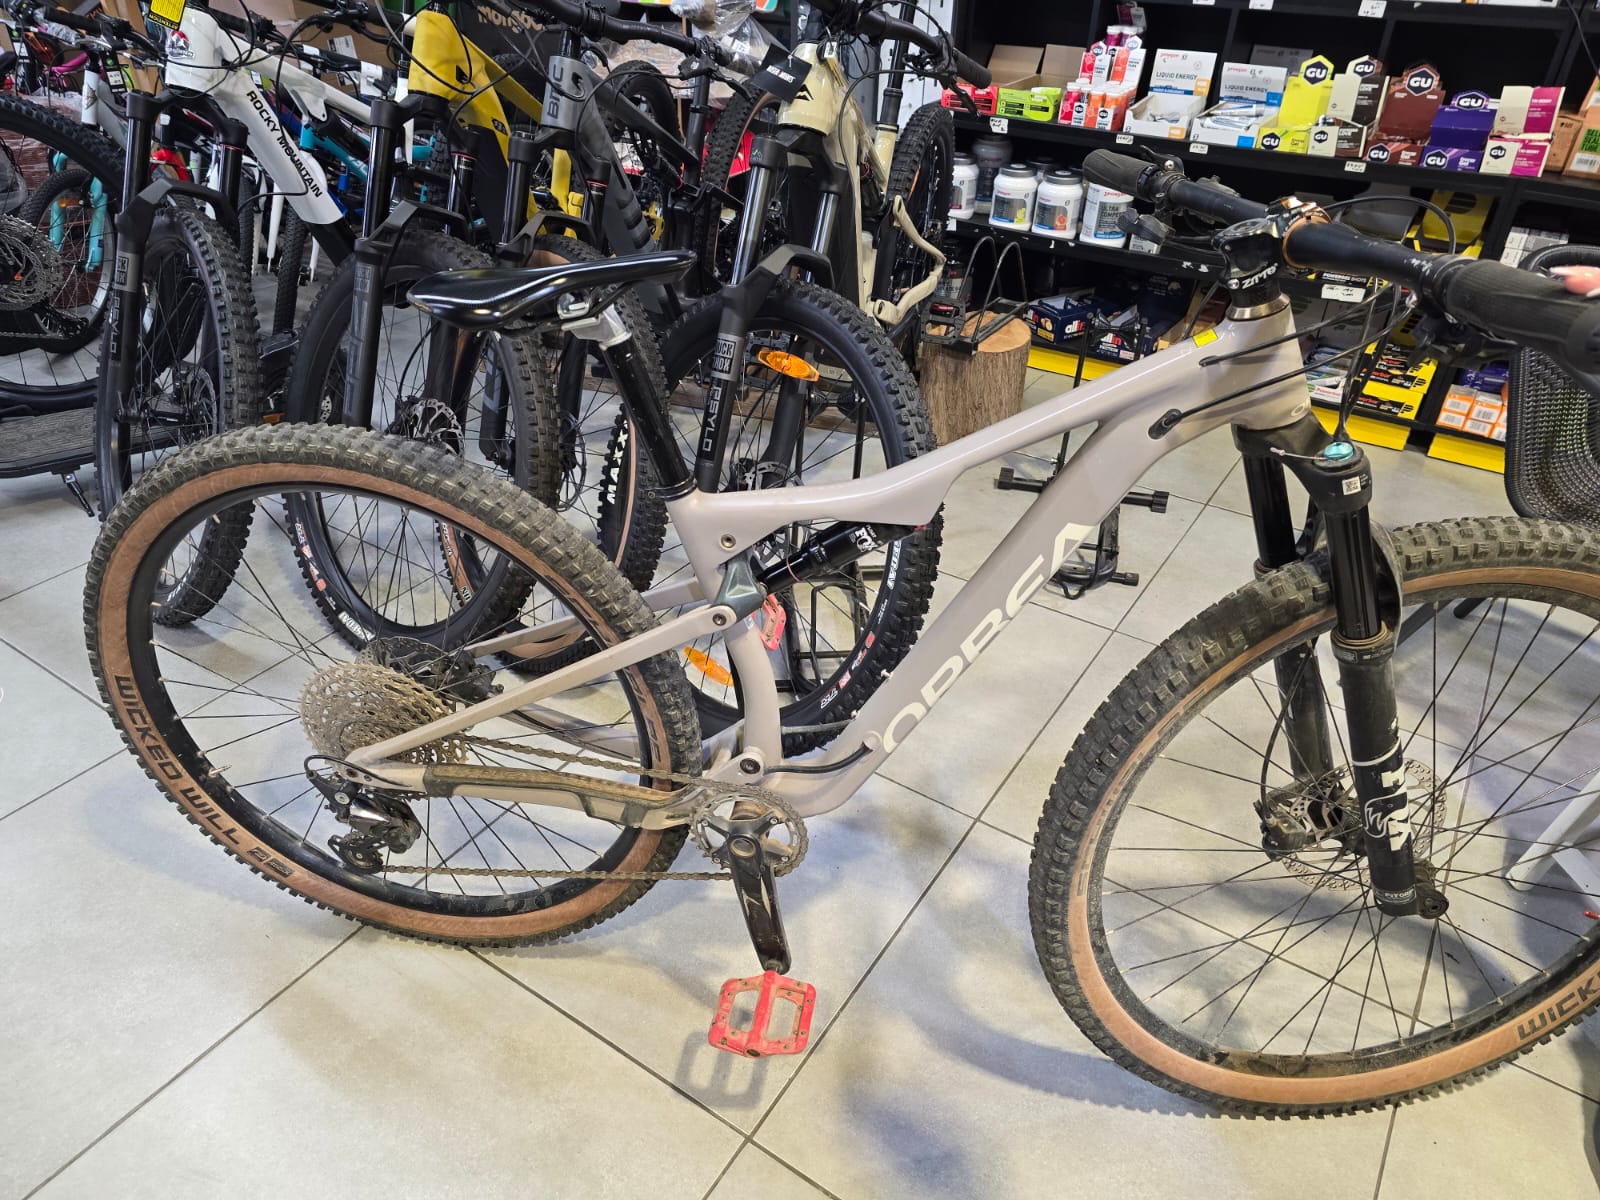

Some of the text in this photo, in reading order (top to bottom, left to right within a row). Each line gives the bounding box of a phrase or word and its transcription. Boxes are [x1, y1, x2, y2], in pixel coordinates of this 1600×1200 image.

[1306, 67, 1327, 78] GU
[1355, 63, 1374, 73] GU
[1156, 71, 1198, 81] LIQUID ENERGY
[1408, 76, 1433, 89] GU
[1225, 84, 1269, 93] LIQUID ENERGY
[1458, 97, 1485, 108] GU
[246, 91, 281, 133] ROCKY
[1262, 136, 1280, 147] GU
[1315, 133, 1328, 141] GU
[1369, 149, 1388, 159] GU
[1491, 148, 1505, 157] GU
[1425, 155, 1447, 167] GU
[277, 135, 323, 199] MOUNTAIN
[714, 339, 735, 356] OCK
[855, 527, 879, 553] FOX
[114, 674, 241, 846] WICKED WILL
[1517, 972, 1600, 1040] WICK
